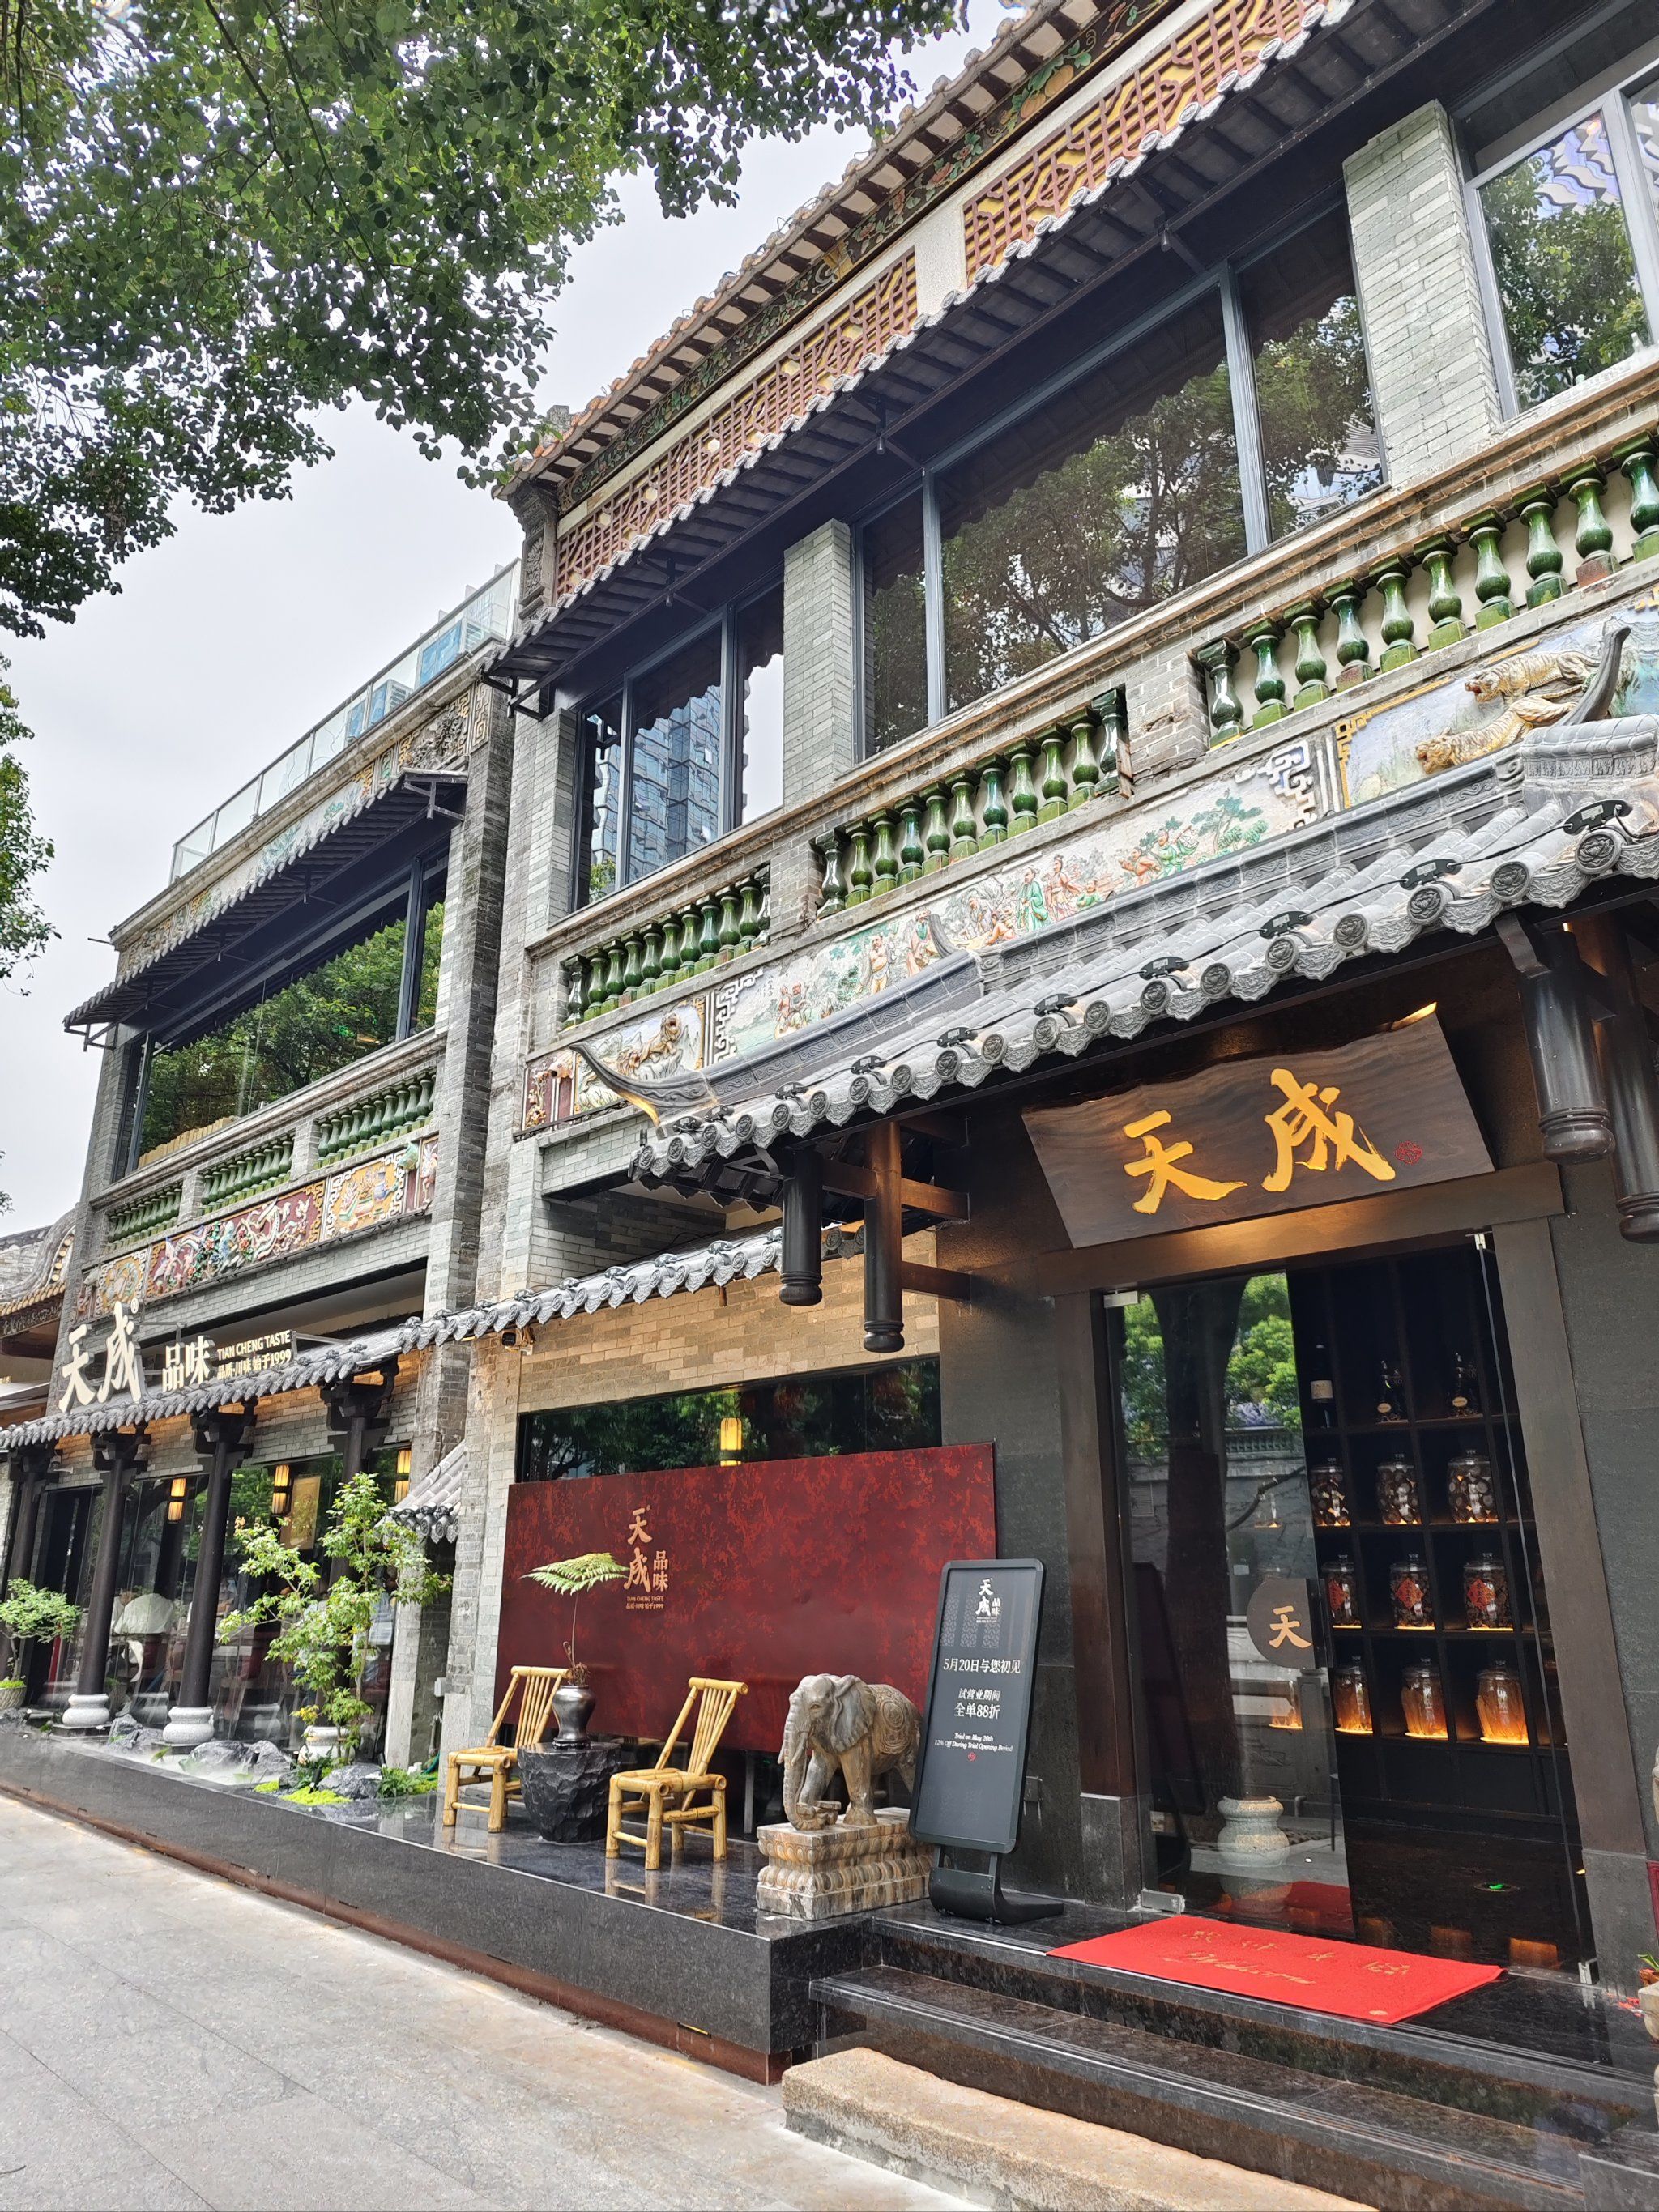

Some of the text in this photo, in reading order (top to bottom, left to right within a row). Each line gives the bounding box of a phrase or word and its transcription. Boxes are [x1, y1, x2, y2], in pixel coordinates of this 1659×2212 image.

[1124, 1068, 1396, 1214] 天成
[58, 1301, 211, 1413] 天成 品味
[217, 1329, 291, 1361] TIAN CHENG TASTE
[624, 1507, 652, 1592] 天成
[653, 1549, 668, 1592] 品味
[1269, 1605, 1312, 1648] 天
[943, 1657, 1021, 1673] 5月20日与您初见
[958, 1687, 1001, 1701] 试营业期间
[954, 1702, 1000, 1720] 全单88折
[952, 1741, 967, 1750] During
[979, 1743, 997, 1752] Opening
[972, 1734, 982, 1742] May
